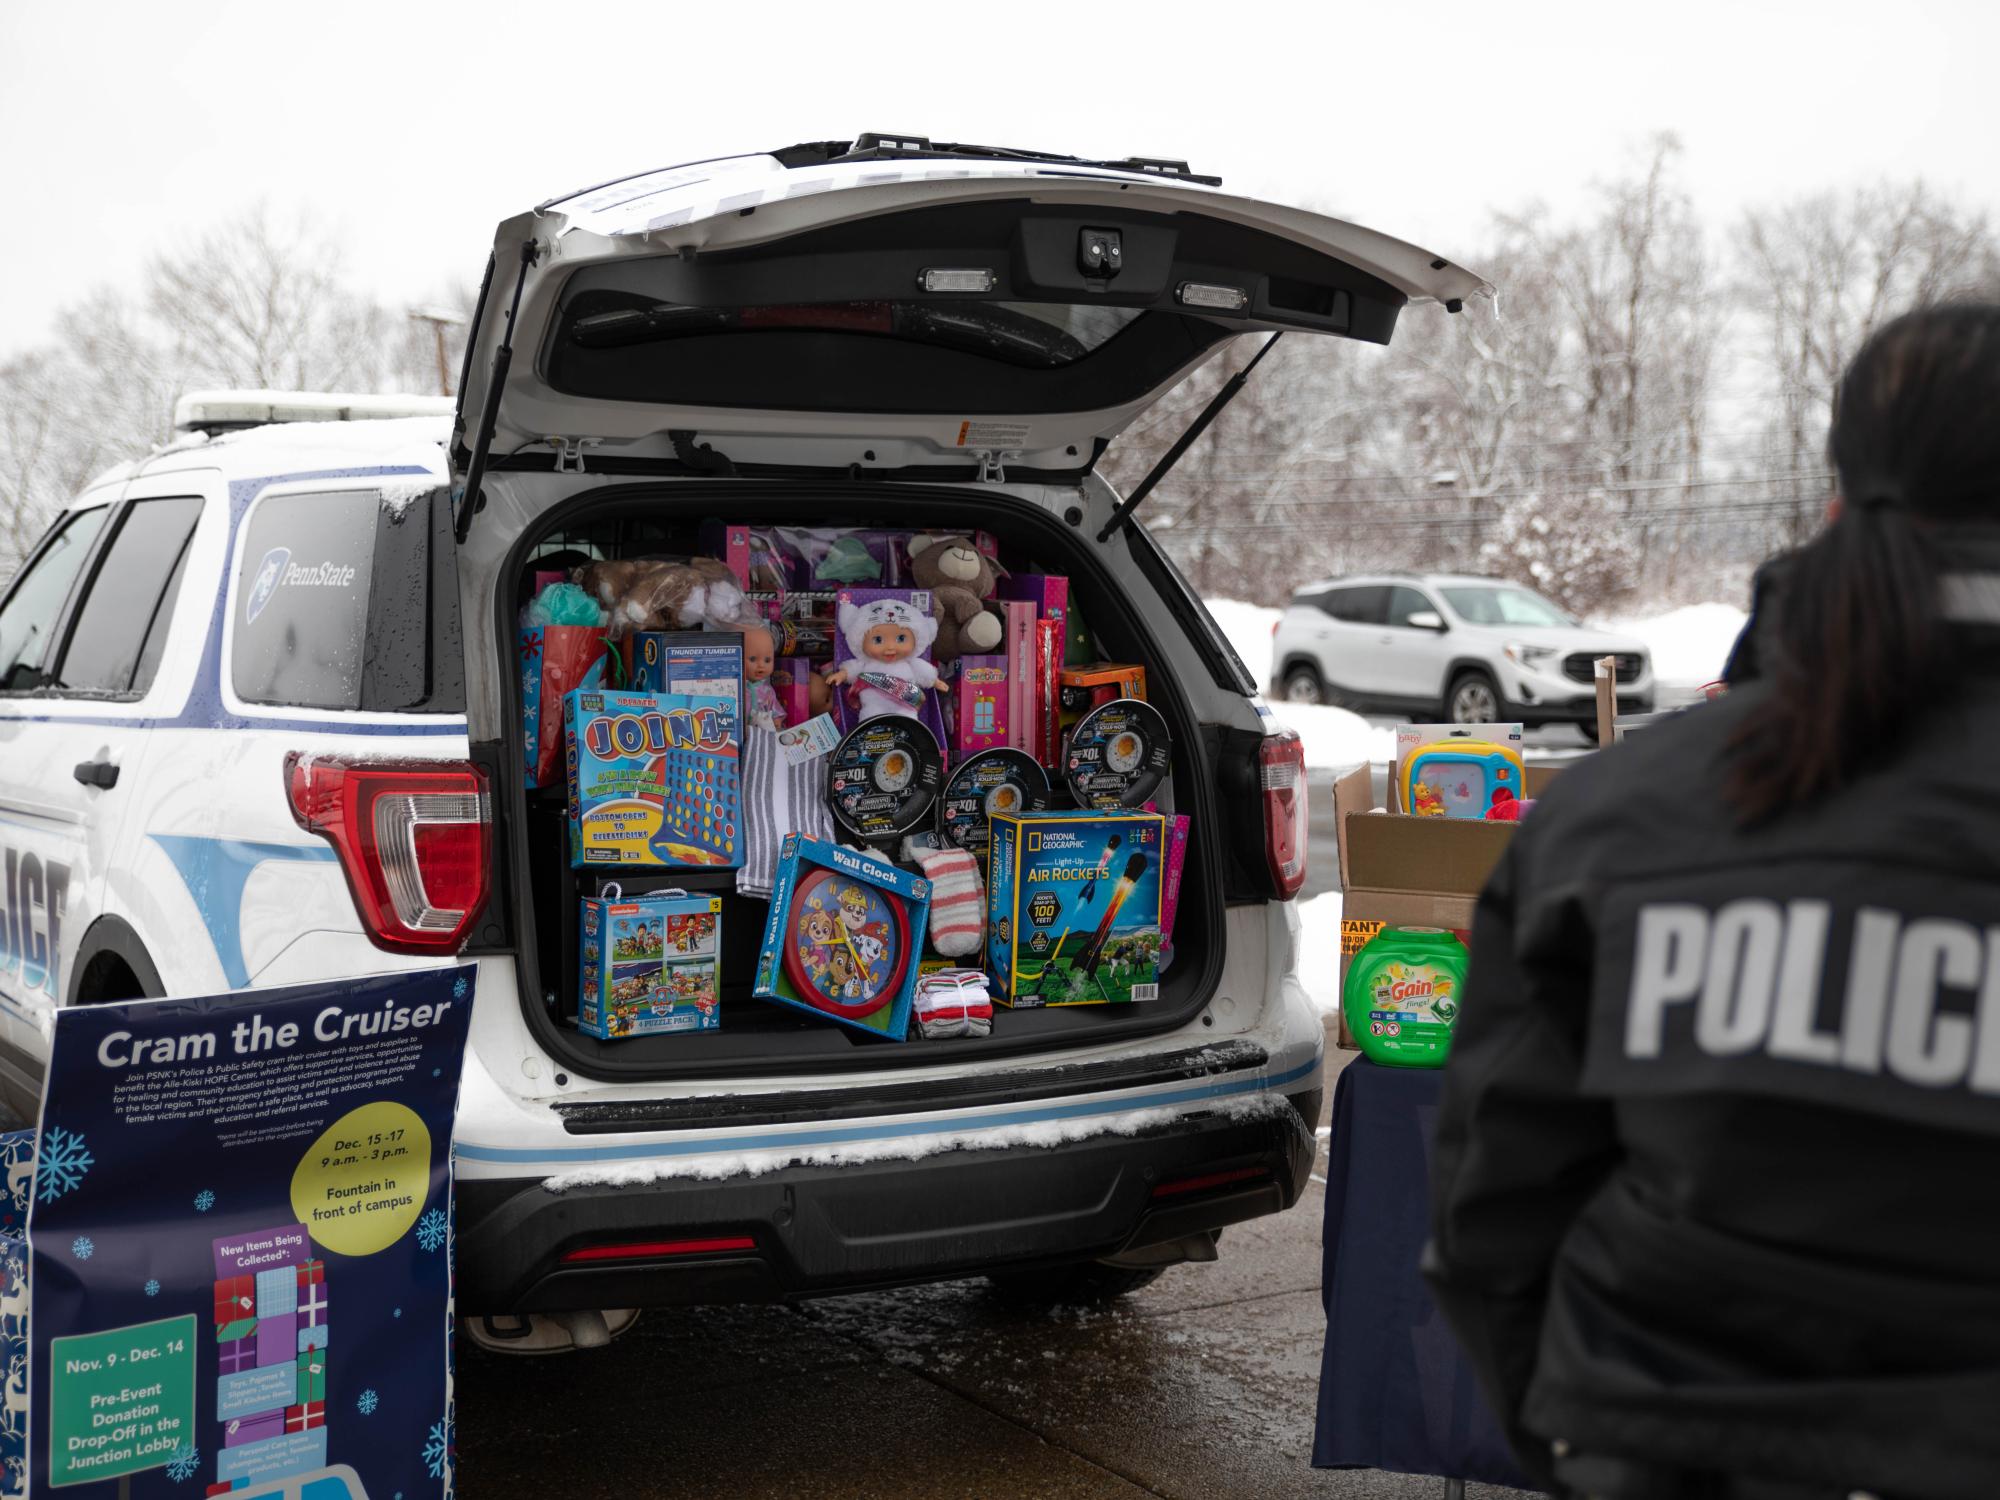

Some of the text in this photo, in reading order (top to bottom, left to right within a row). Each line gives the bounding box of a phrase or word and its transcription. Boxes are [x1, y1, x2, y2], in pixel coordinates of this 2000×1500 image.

[282, 561, 355, 586] PennState
[593, 712, 721, 755] JOIN 4
[1042, 840, 1085, 850] GEOGRAPHIC
[1043, 832, 1076, 841] NATIONAL
[833, 851, 860, 870] Wall
[862, 862, 898, 884] Clock
[1028, 867, 1110, 883] AIR ROCKETS
[1054, 858, 1085, 868] Light-Up
[768, 877, 786, 945] Wall Clock
[1034, 905, 1055, 918] 100
[882, 923, 889, 936] 2
[1341, 921, 1380, 933] TANT
[1392, 980, 1433, 1002] Gain
[645, 1018, 672, 1027] PUZZLE
[674, 1015, 694, 1024] PACK
[98, 1000, 452, 1068] Cram the Cruiser
[114, 1043, 423, 1092] benefit the Alle-Kiski HOPE Center, which offers supportive services, opportunities
[126, 1073, 144, 1081] Join
[179, 1068, 205, 1077] Police
[206, 1066, 214, 1074] &
[215, 1063, 240, 1073] Public
[241, 1059, 266, 1069] Safety
[266, 1057, 285, 1065] cram
[287, 1052, 304, 1062] their
[305, 1049, 330, 1059] cruiser
[331, 1045, 347, 1055] with
[348, 1044, 364, 1053] toys
[365, 1040, 380, 1049] and
[380, 1036, 408, 1048] supplies
[410, 1035, 418, 1043] to
[113, 1053, 421, 1102] for healing and community education to assist victims and end violence and abuse
[115, 1062, 416, 1113] in the local region. Their emergency sheltering and protection programs provide
[126, 1113, 155, 1123] female
[157, 1111, 186, 1120] victims
[188, 1107, 204, 1117] and
[206, 1105, 225, 1115] their
[226, 1101, 257, 1112] children
[265, 1096, 281, 1106] safe
[282, 1094, 304, 1105] place,
[305, 1091, 314, 1099] as
[315, 1087, 330, 1097] well
[340, 1081, 374, 1092] advocacy,
[375, 1074, 404, 1087] support,
[214, 1099, 330, 1123] education and referral services.
[334, 1140, 362, 1151] Dec.
[368, 1134, 382, 1146] 15
[321, 1158, 330, 1168] 9
[332, 1155, 359, 1166] a.m.
[371, 1150, 379, 1160] 3
[382, 1147, 409, 1160] p.m.
[327, 1179, 396, 1200] Fountain in
[313, 1195, 413, 1220] front of campus
[221, 1235, 302, 1257] New Items Being
[66, 1360, 102, 1374] Nov.
[107, 1354, 117, 1367] 9
[130, 1347, 162, 1362] Dec.
[167, 1339, 184, 1354] 14
[91, 1383, 162, 1409] Pre-Event
[93, 1404, 160, 1428] Donation
[68, 1418, 180, 1451] Drop-Off in the
[67, 1436, 180, 1470] Junction Lobby
